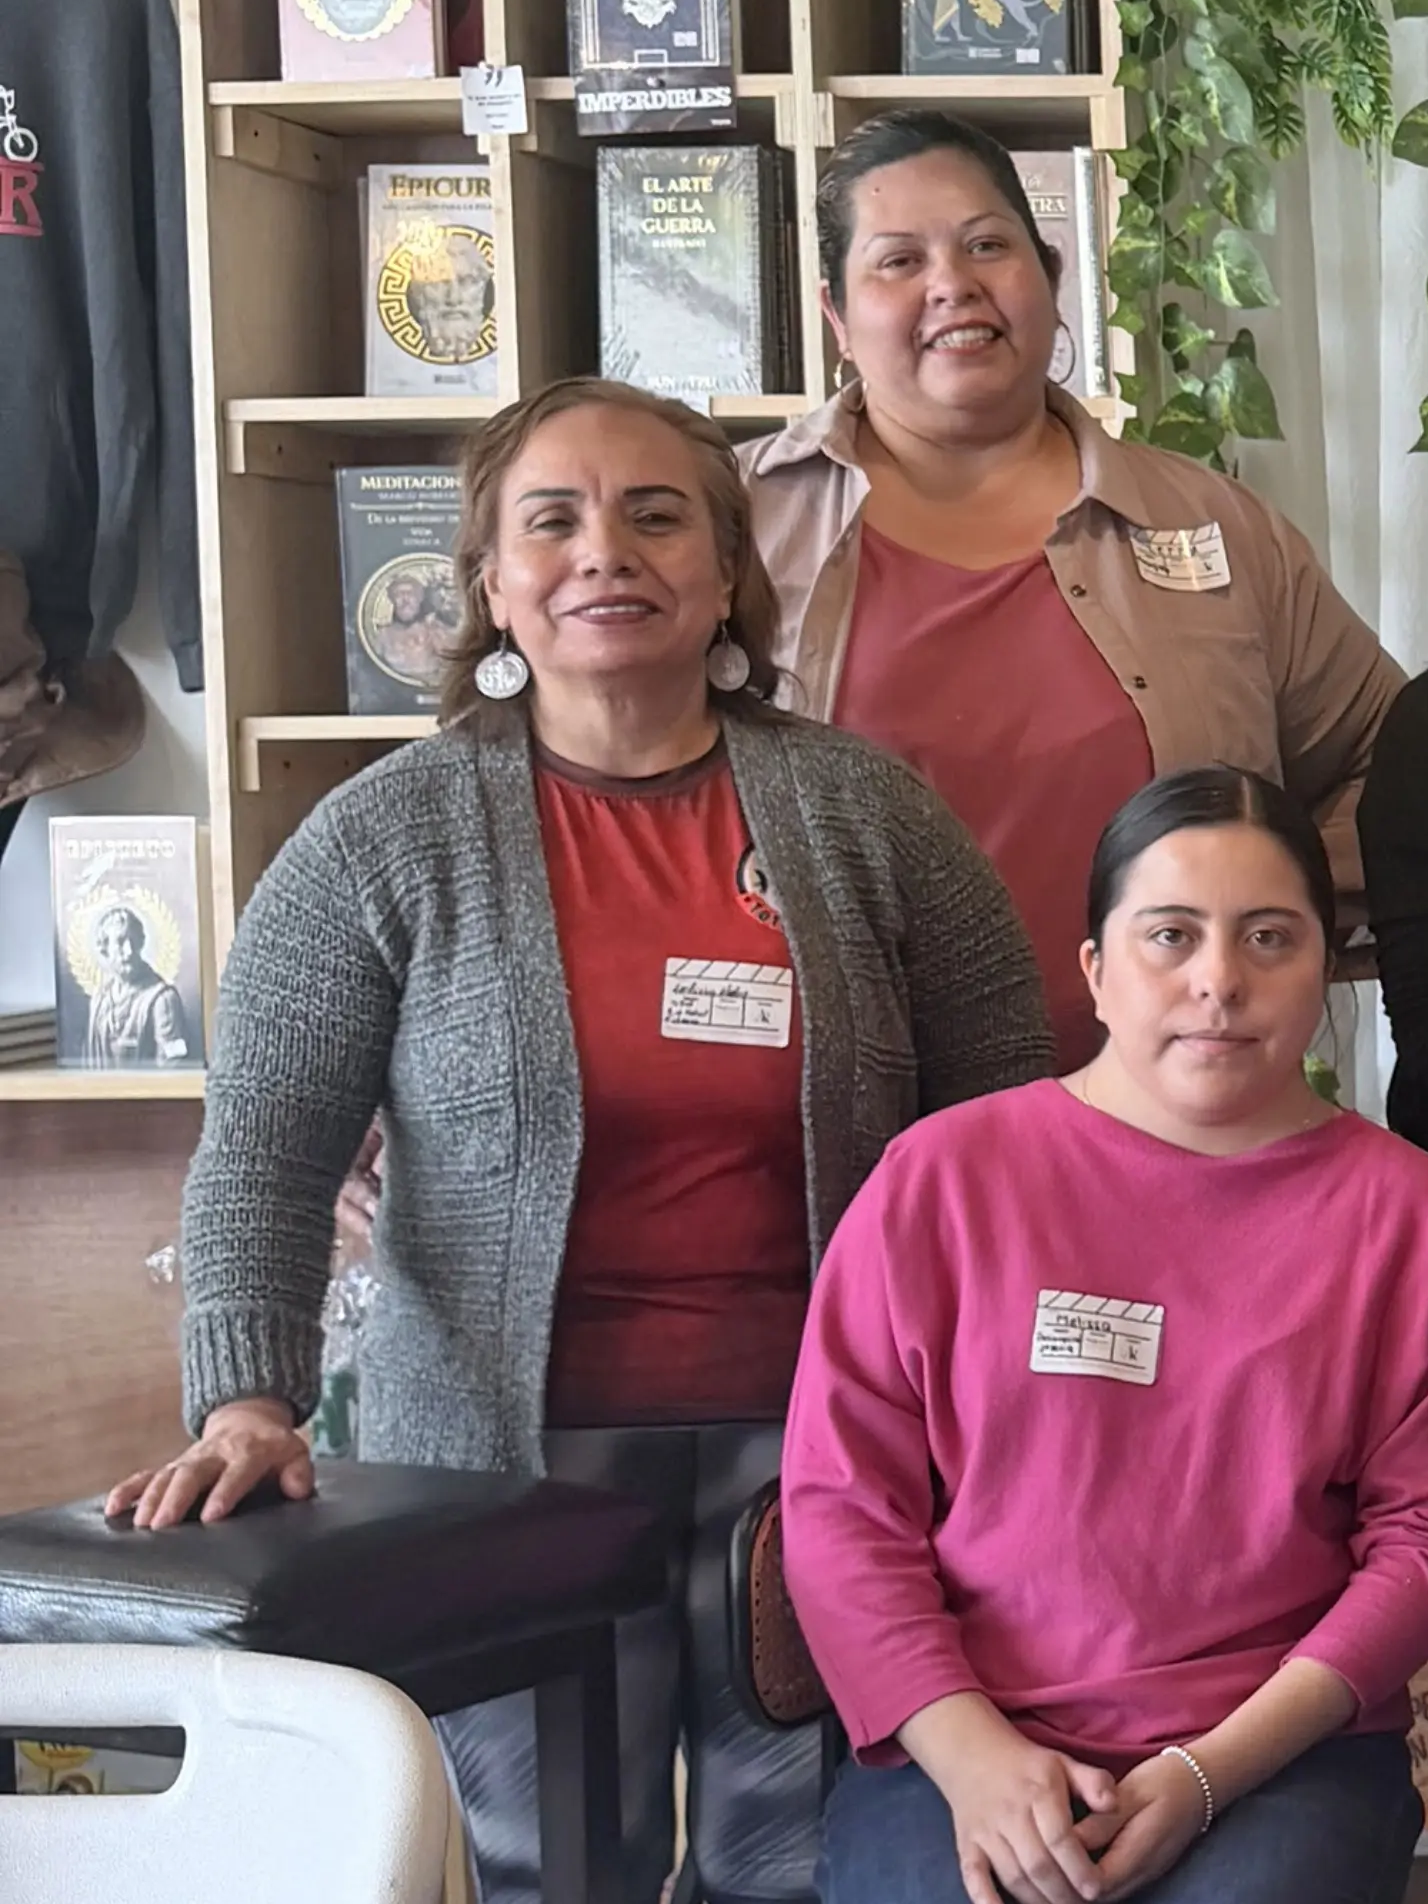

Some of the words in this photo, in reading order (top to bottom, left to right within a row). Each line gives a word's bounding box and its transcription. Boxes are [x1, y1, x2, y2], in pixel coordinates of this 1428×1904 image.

[578, 86, 732, 114] IMPERDIBLES
[643, 177, 664, 194] EL
[668, 176, 714, 194] ARTE
[653, 198, 678, 214] DE
[681, 198, 704, 214] LA
[641, 217, 717, 235] GUERRA
